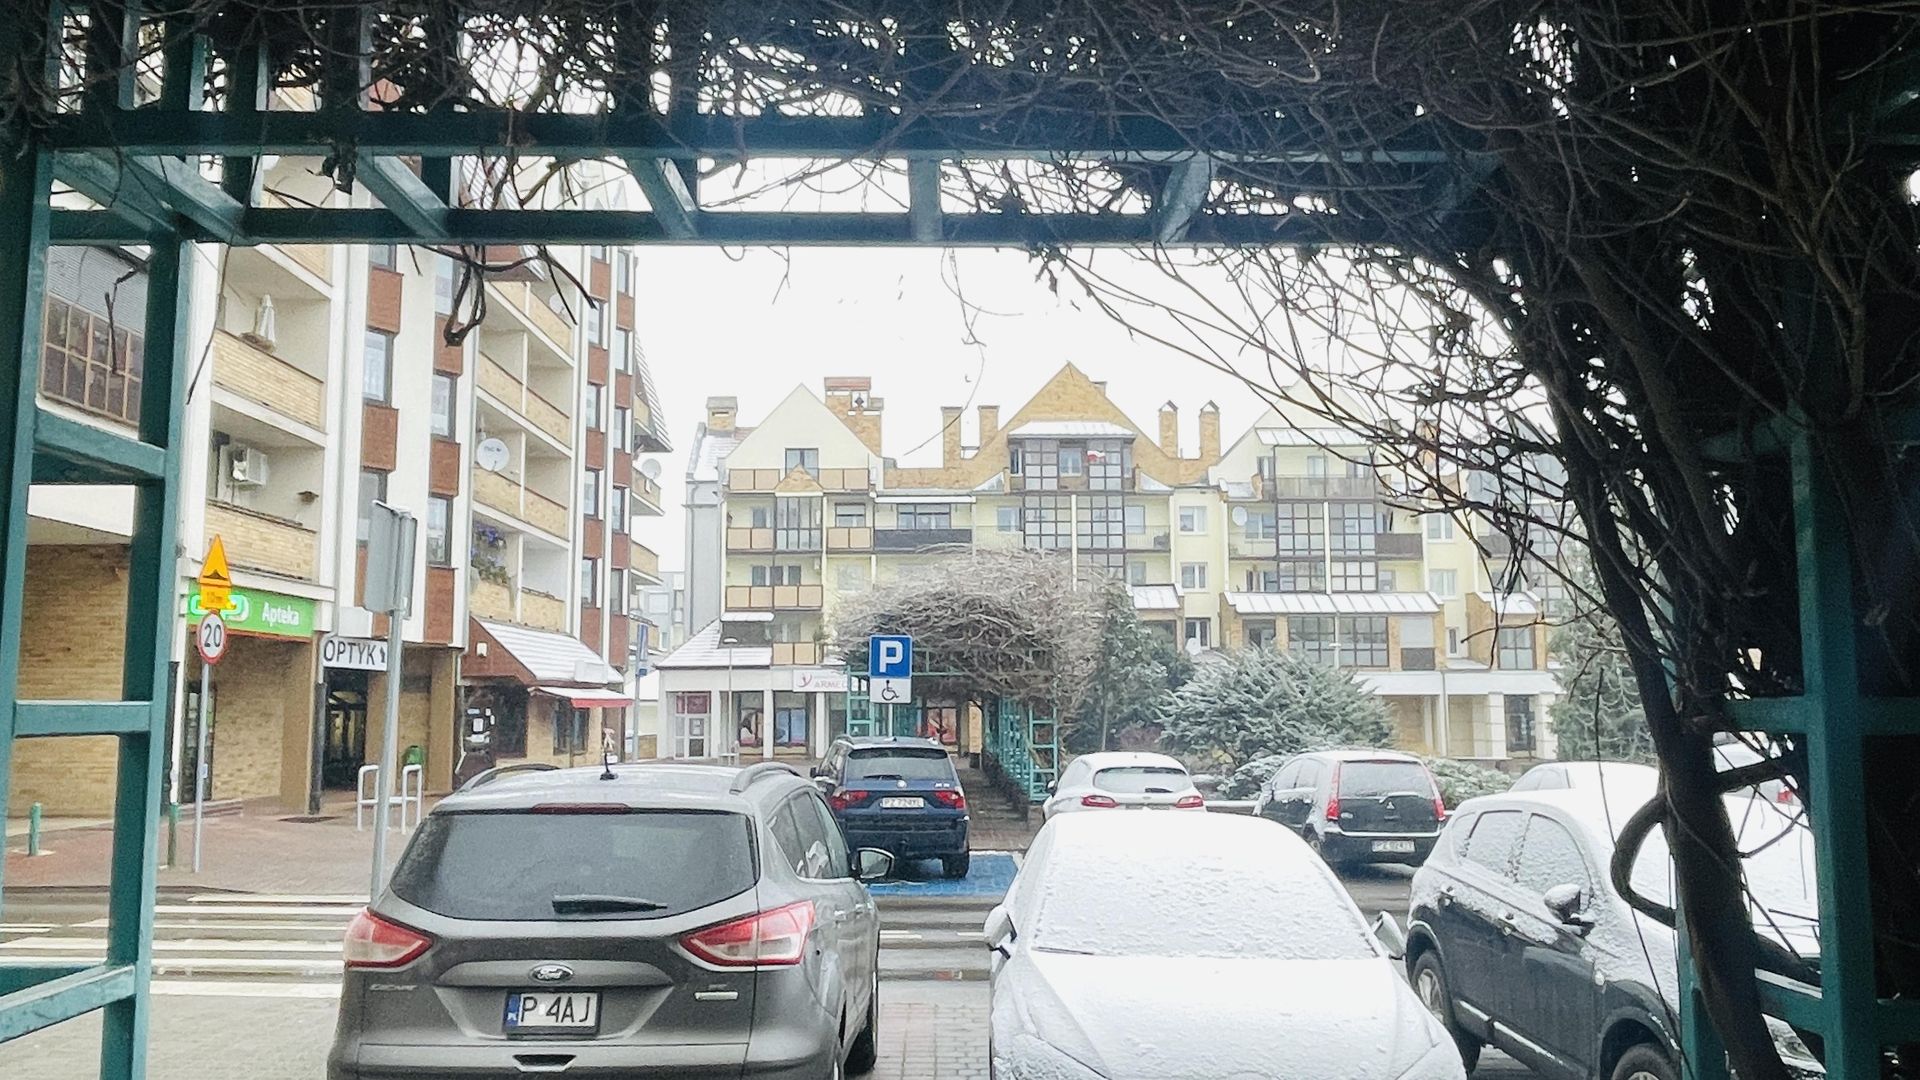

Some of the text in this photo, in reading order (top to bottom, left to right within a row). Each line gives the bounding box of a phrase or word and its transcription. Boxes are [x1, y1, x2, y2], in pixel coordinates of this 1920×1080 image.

[262, 601, 299, 627] Apteka
[204, 623, 223, 648] 20
[324, 640, 375, 665] OPTYK
[879, 640, 903, 673] P
